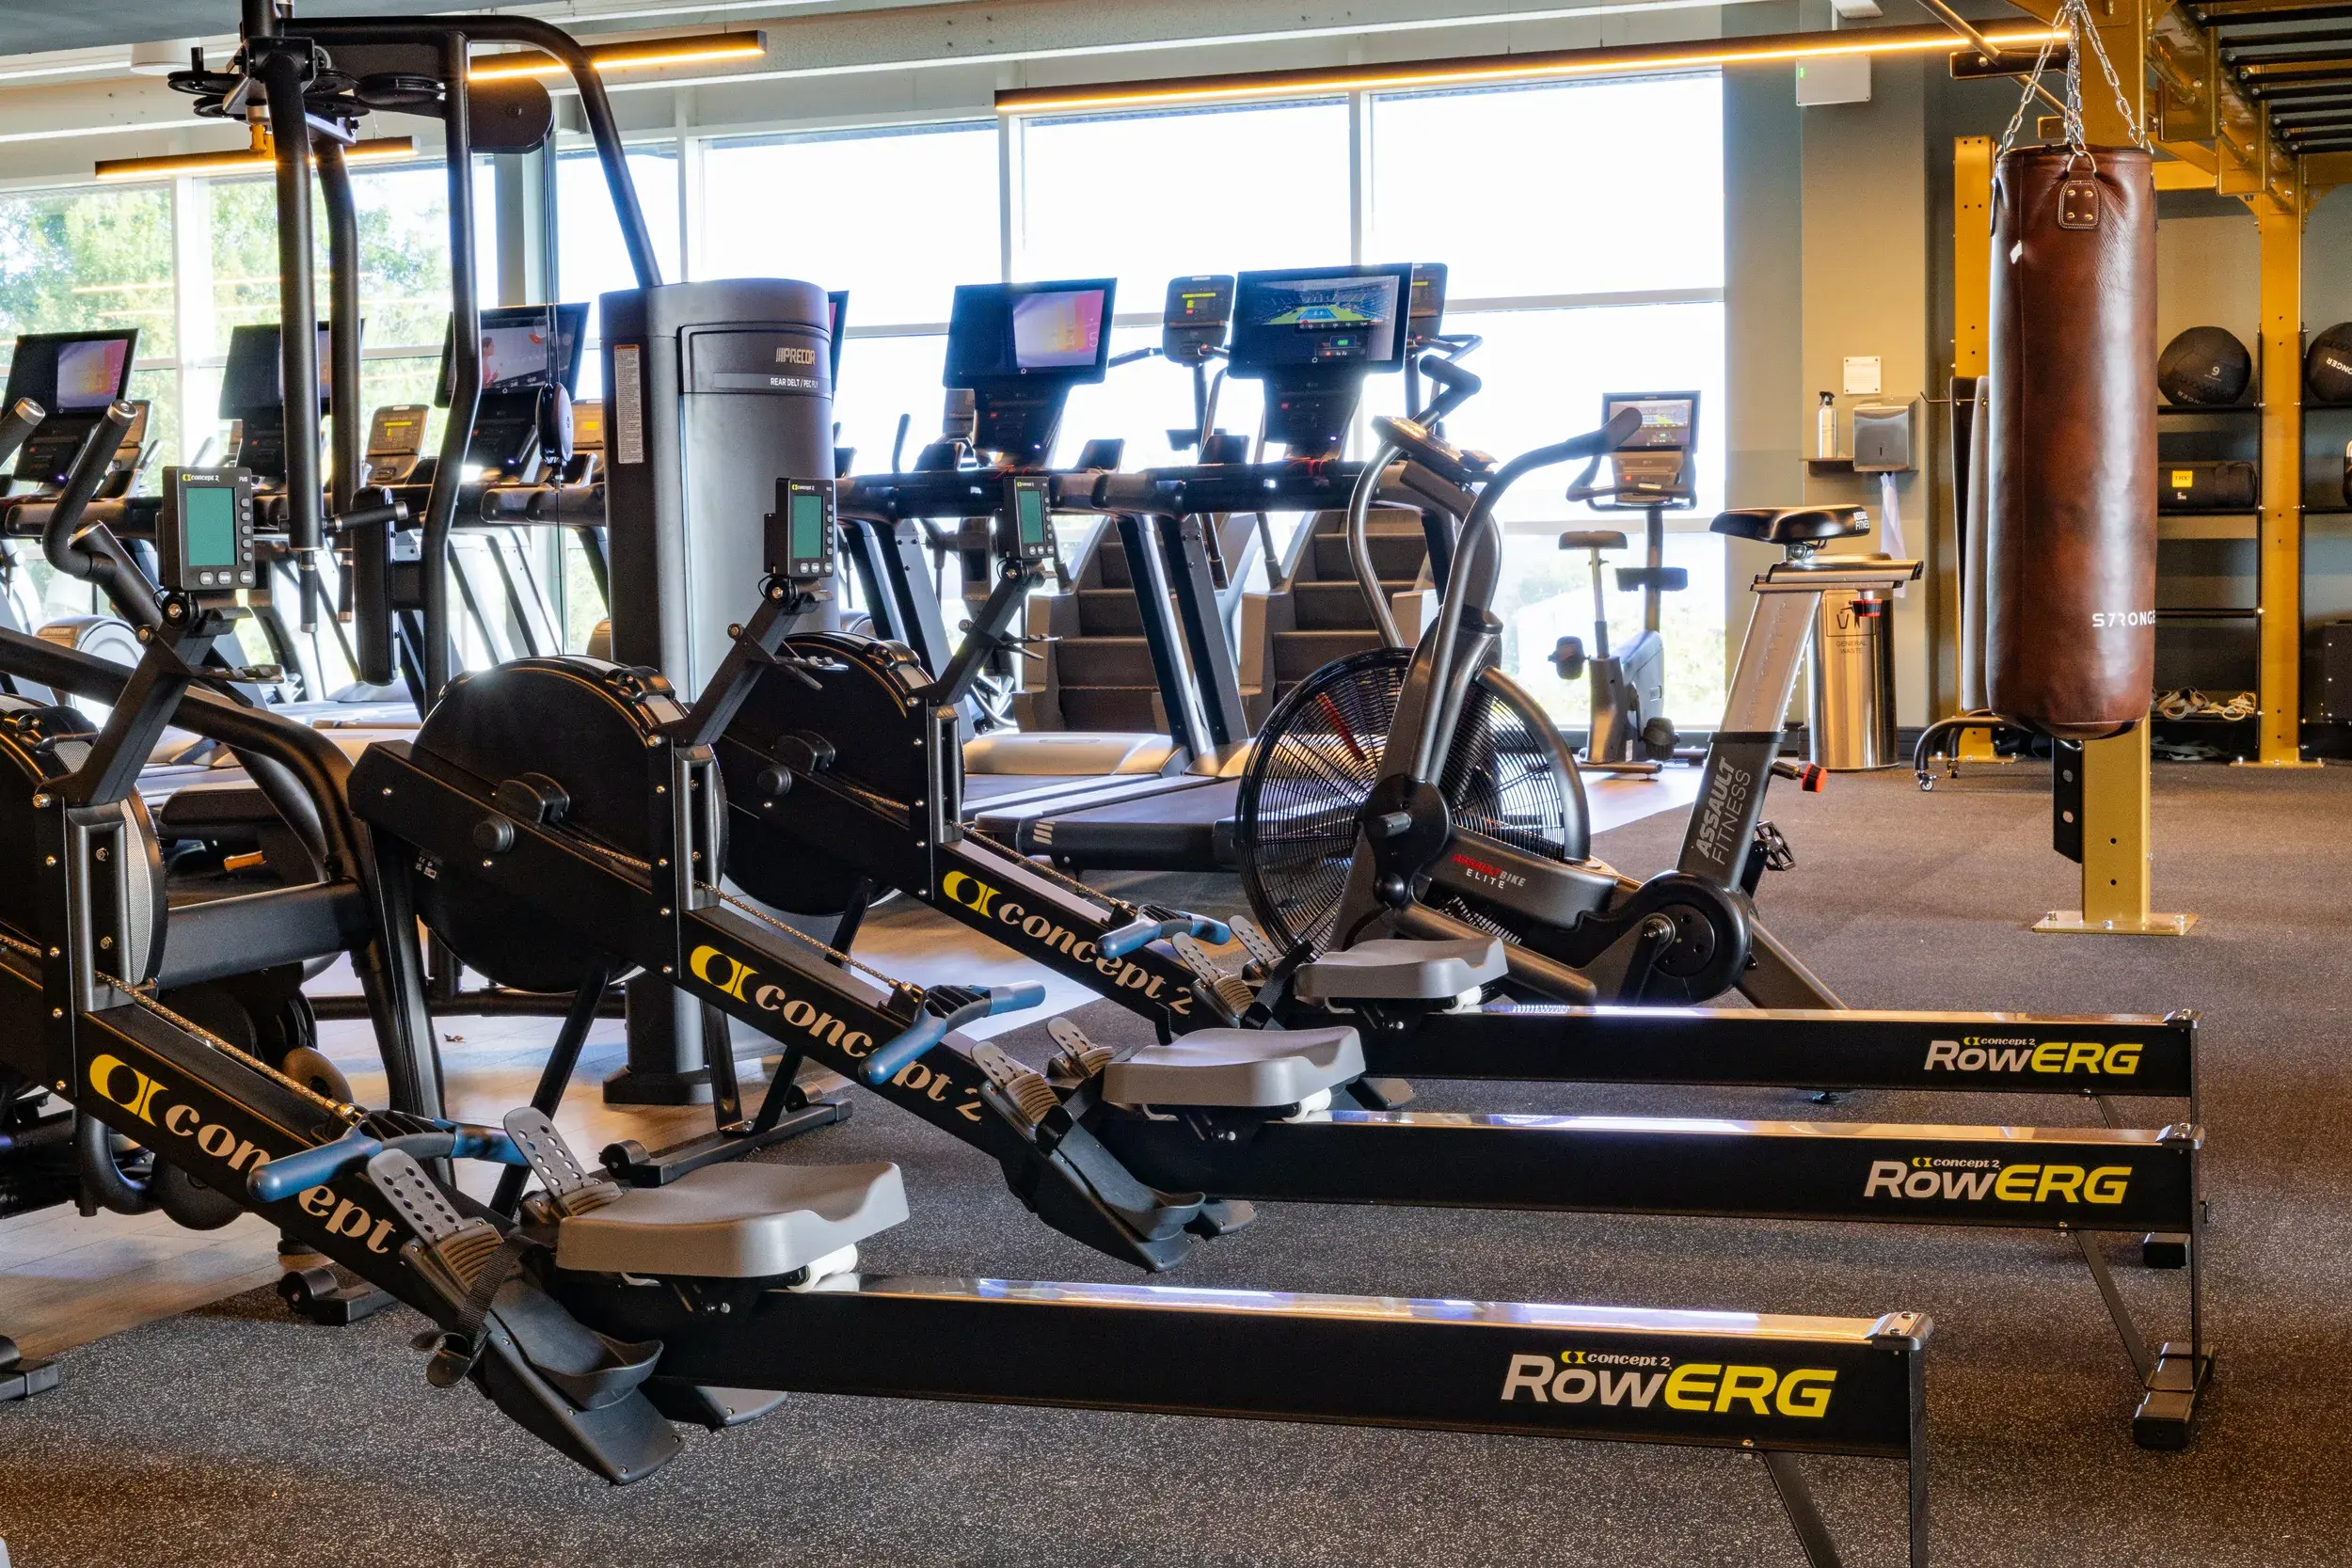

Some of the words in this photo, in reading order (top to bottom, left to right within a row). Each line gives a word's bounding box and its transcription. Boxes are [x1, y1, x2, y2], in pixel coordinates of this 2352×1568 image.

[782, 347, 816, 365] PRECOR
[770, 377, 787, 386] REAR
[787, 378, 801, 387] DELT
[803, 379, 812, 388] PEC
[1695, 755, 1735, 859] ASSAULT
[1711, 768, 1751, 865] FITNESS
[1466, 868, 1505, 889] ELITE
[1168, 987, 1193, 1015] 2
[755, 985, 953, 1101] concpt
[1980, 1037, 2027, 1046] concept
[2028, 1037, 2036, 1046] 2
[1933, 1158, 1990, 1168] concept
[1992, 1159, 2000, 1169] 2
[165, 1104, 397, 1255] conept
[1587, 1353, 1659, 1367] concept
[1661, 1356, 1671, 1368] 2
